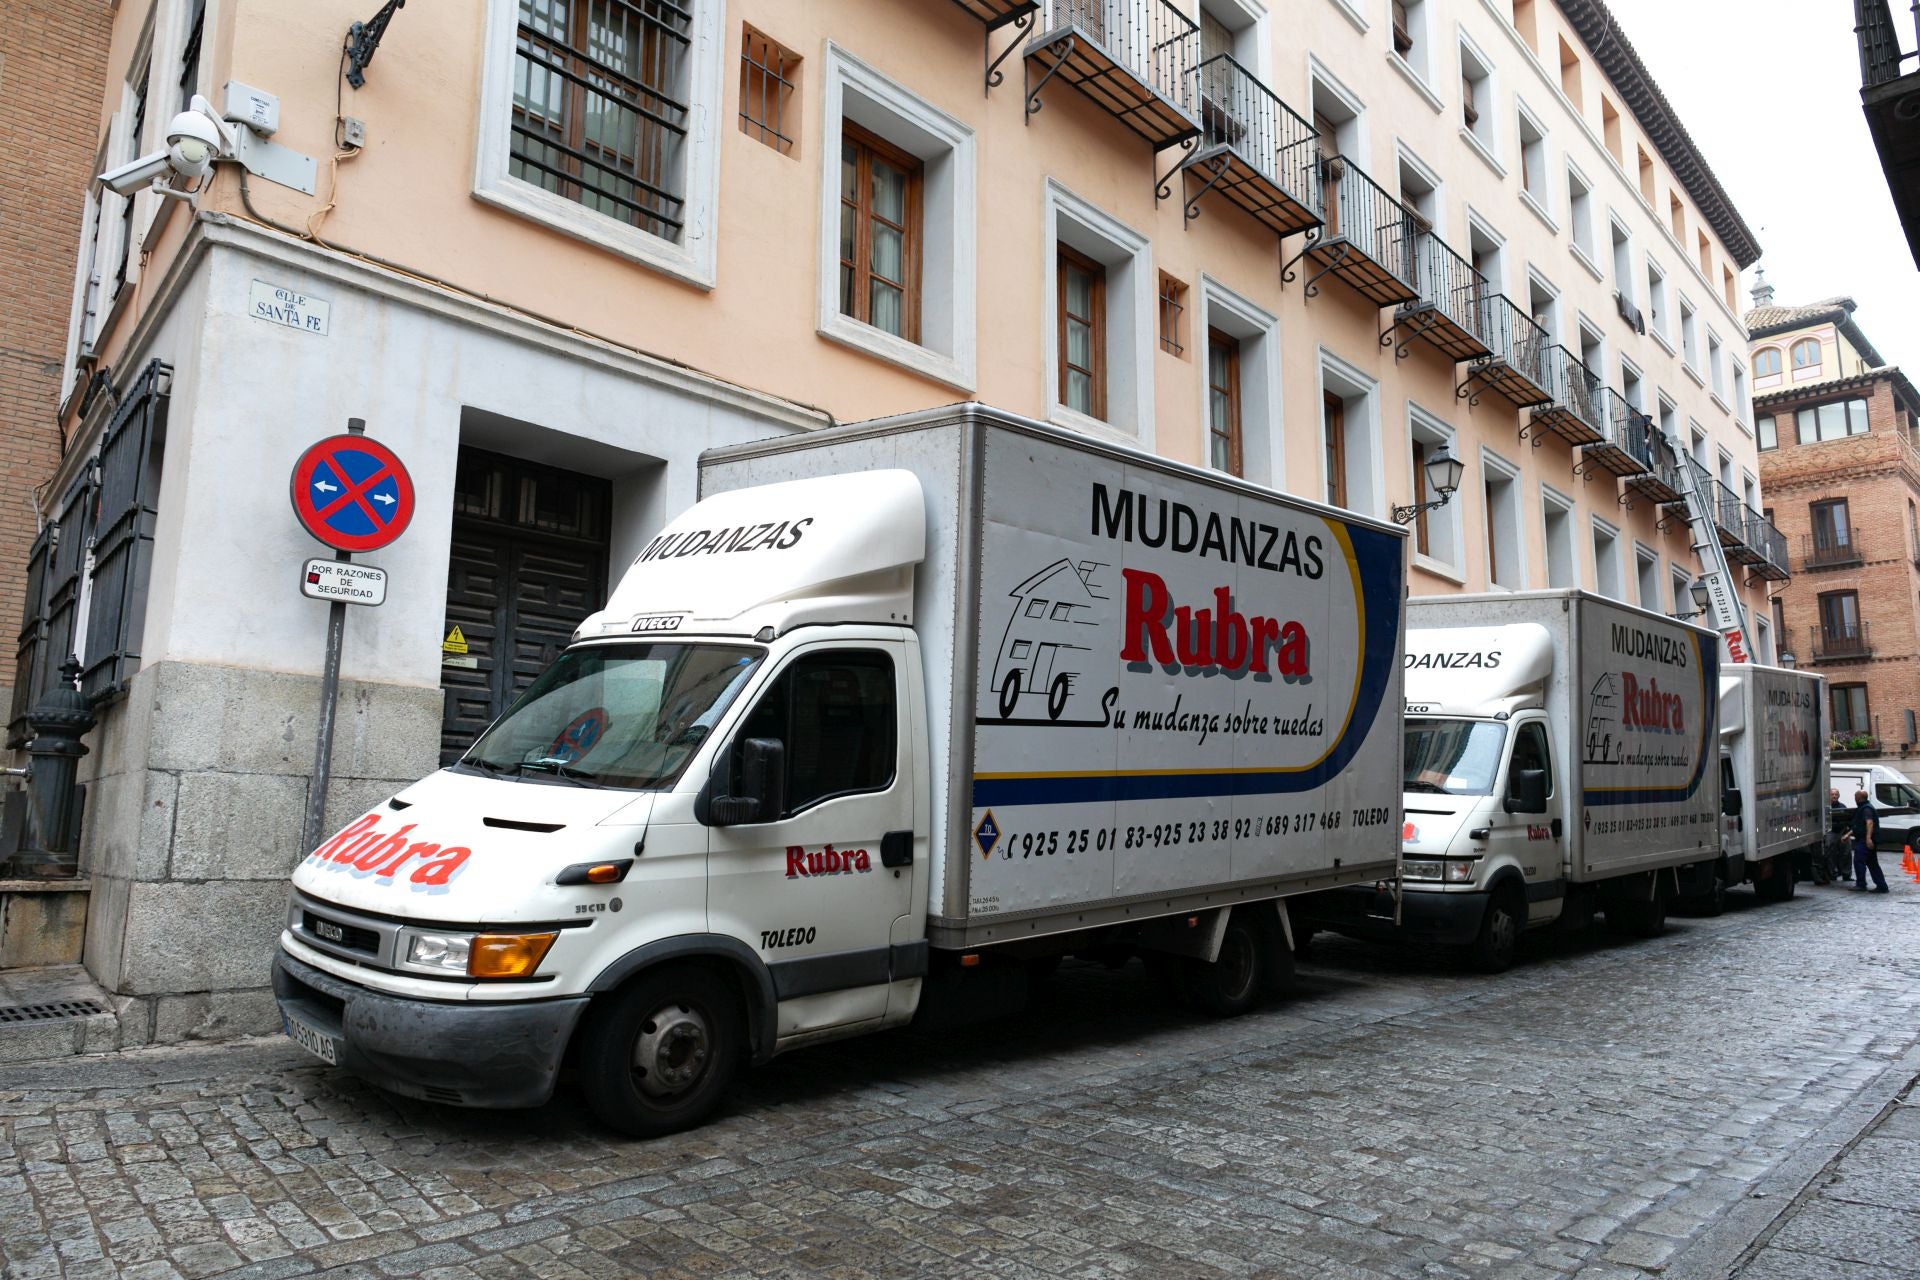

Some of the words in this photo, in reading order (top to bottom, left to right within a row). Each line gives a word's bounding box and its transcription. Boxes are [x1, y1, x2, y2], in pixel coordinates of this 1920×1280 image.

[256, 301, 300, 325] SANTA
[306, 315, 321, 331] FE
[634, 517, 814, 565] MUDANZAS
[1091, 482, 1324, 580] MUDANZAS
[311, 565, 332, 574] POR
[336, 568, 382, 580] RAZONES
[340, 578, 353, 587] DE
[317, 585, 373, 598] SEGURIDAD
[633, 617, 681, 631] IVECO
[1120, 567, 1311, 683] Rubra
[1404, 651, 1501, 669] DANZAS
[1612, 623, 1687, 668] MUDANZAS
[1406, 705, 1429, 713] ECO
[1622, 671, 1685, 734] Rubra
[1768, 689, 1811, 708] MUDANZAS
[1101, 686, 1126, 729] Su
[1133, 694, 1219, 746] mudanza
[1223, 699, 1268, 734] sobre
[1273, 703, 1324, 736] ruedas
[1626, 743, 1654, 775] mudanza
[1654, 744, 1670, 767] sobre
[1022, 831, 1059, 859] 925
[1066, 829, 1090, 854] 25
[1096, 827, 1117, 852] 01
[1188, 821, 1206, 843] 23
[1212, 819, 1229, 841] 38
[1235, 818, 1251, 840] 92
[1266, 815, 1289, 836] 689
[1294, 812, 1316, 833] 317
[1320, 811, 1341, 830] 468
[1352, 807, 1389, 827] TOLEDO
[1527, 823, 1550, 842] Rubra
[309, 814, 472, 893] Rubra
[785, 844, 872, 879] Rubra
[760, 926, 817, 950] TOLEDO
[320, 1035, 334, 1060] AG
